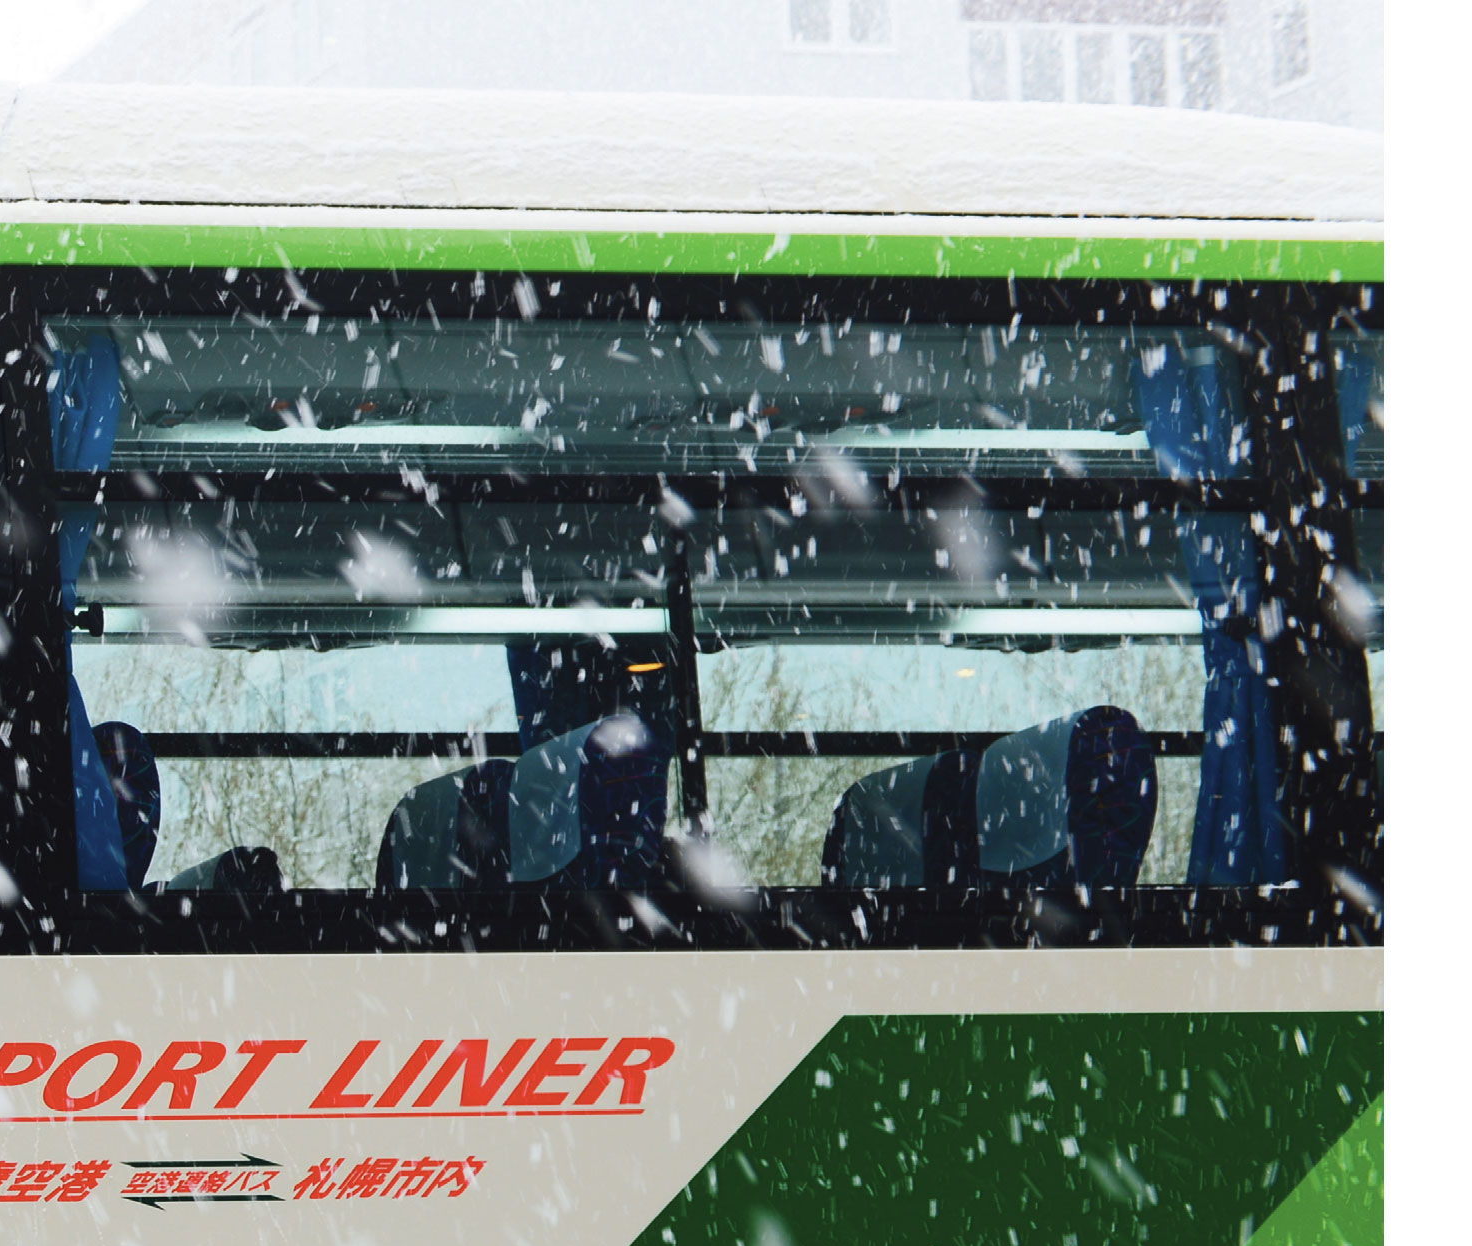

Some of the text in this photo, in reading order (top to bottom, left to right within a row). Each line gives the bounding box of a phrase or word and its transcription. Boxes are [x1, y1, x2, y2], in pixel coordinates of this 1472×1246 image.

[309, 1037, 675, 1109] LINER
[120, 1170, 280, 1194] 空港連絡バス
[294, 1155, 486, 1200] 札幌市内
